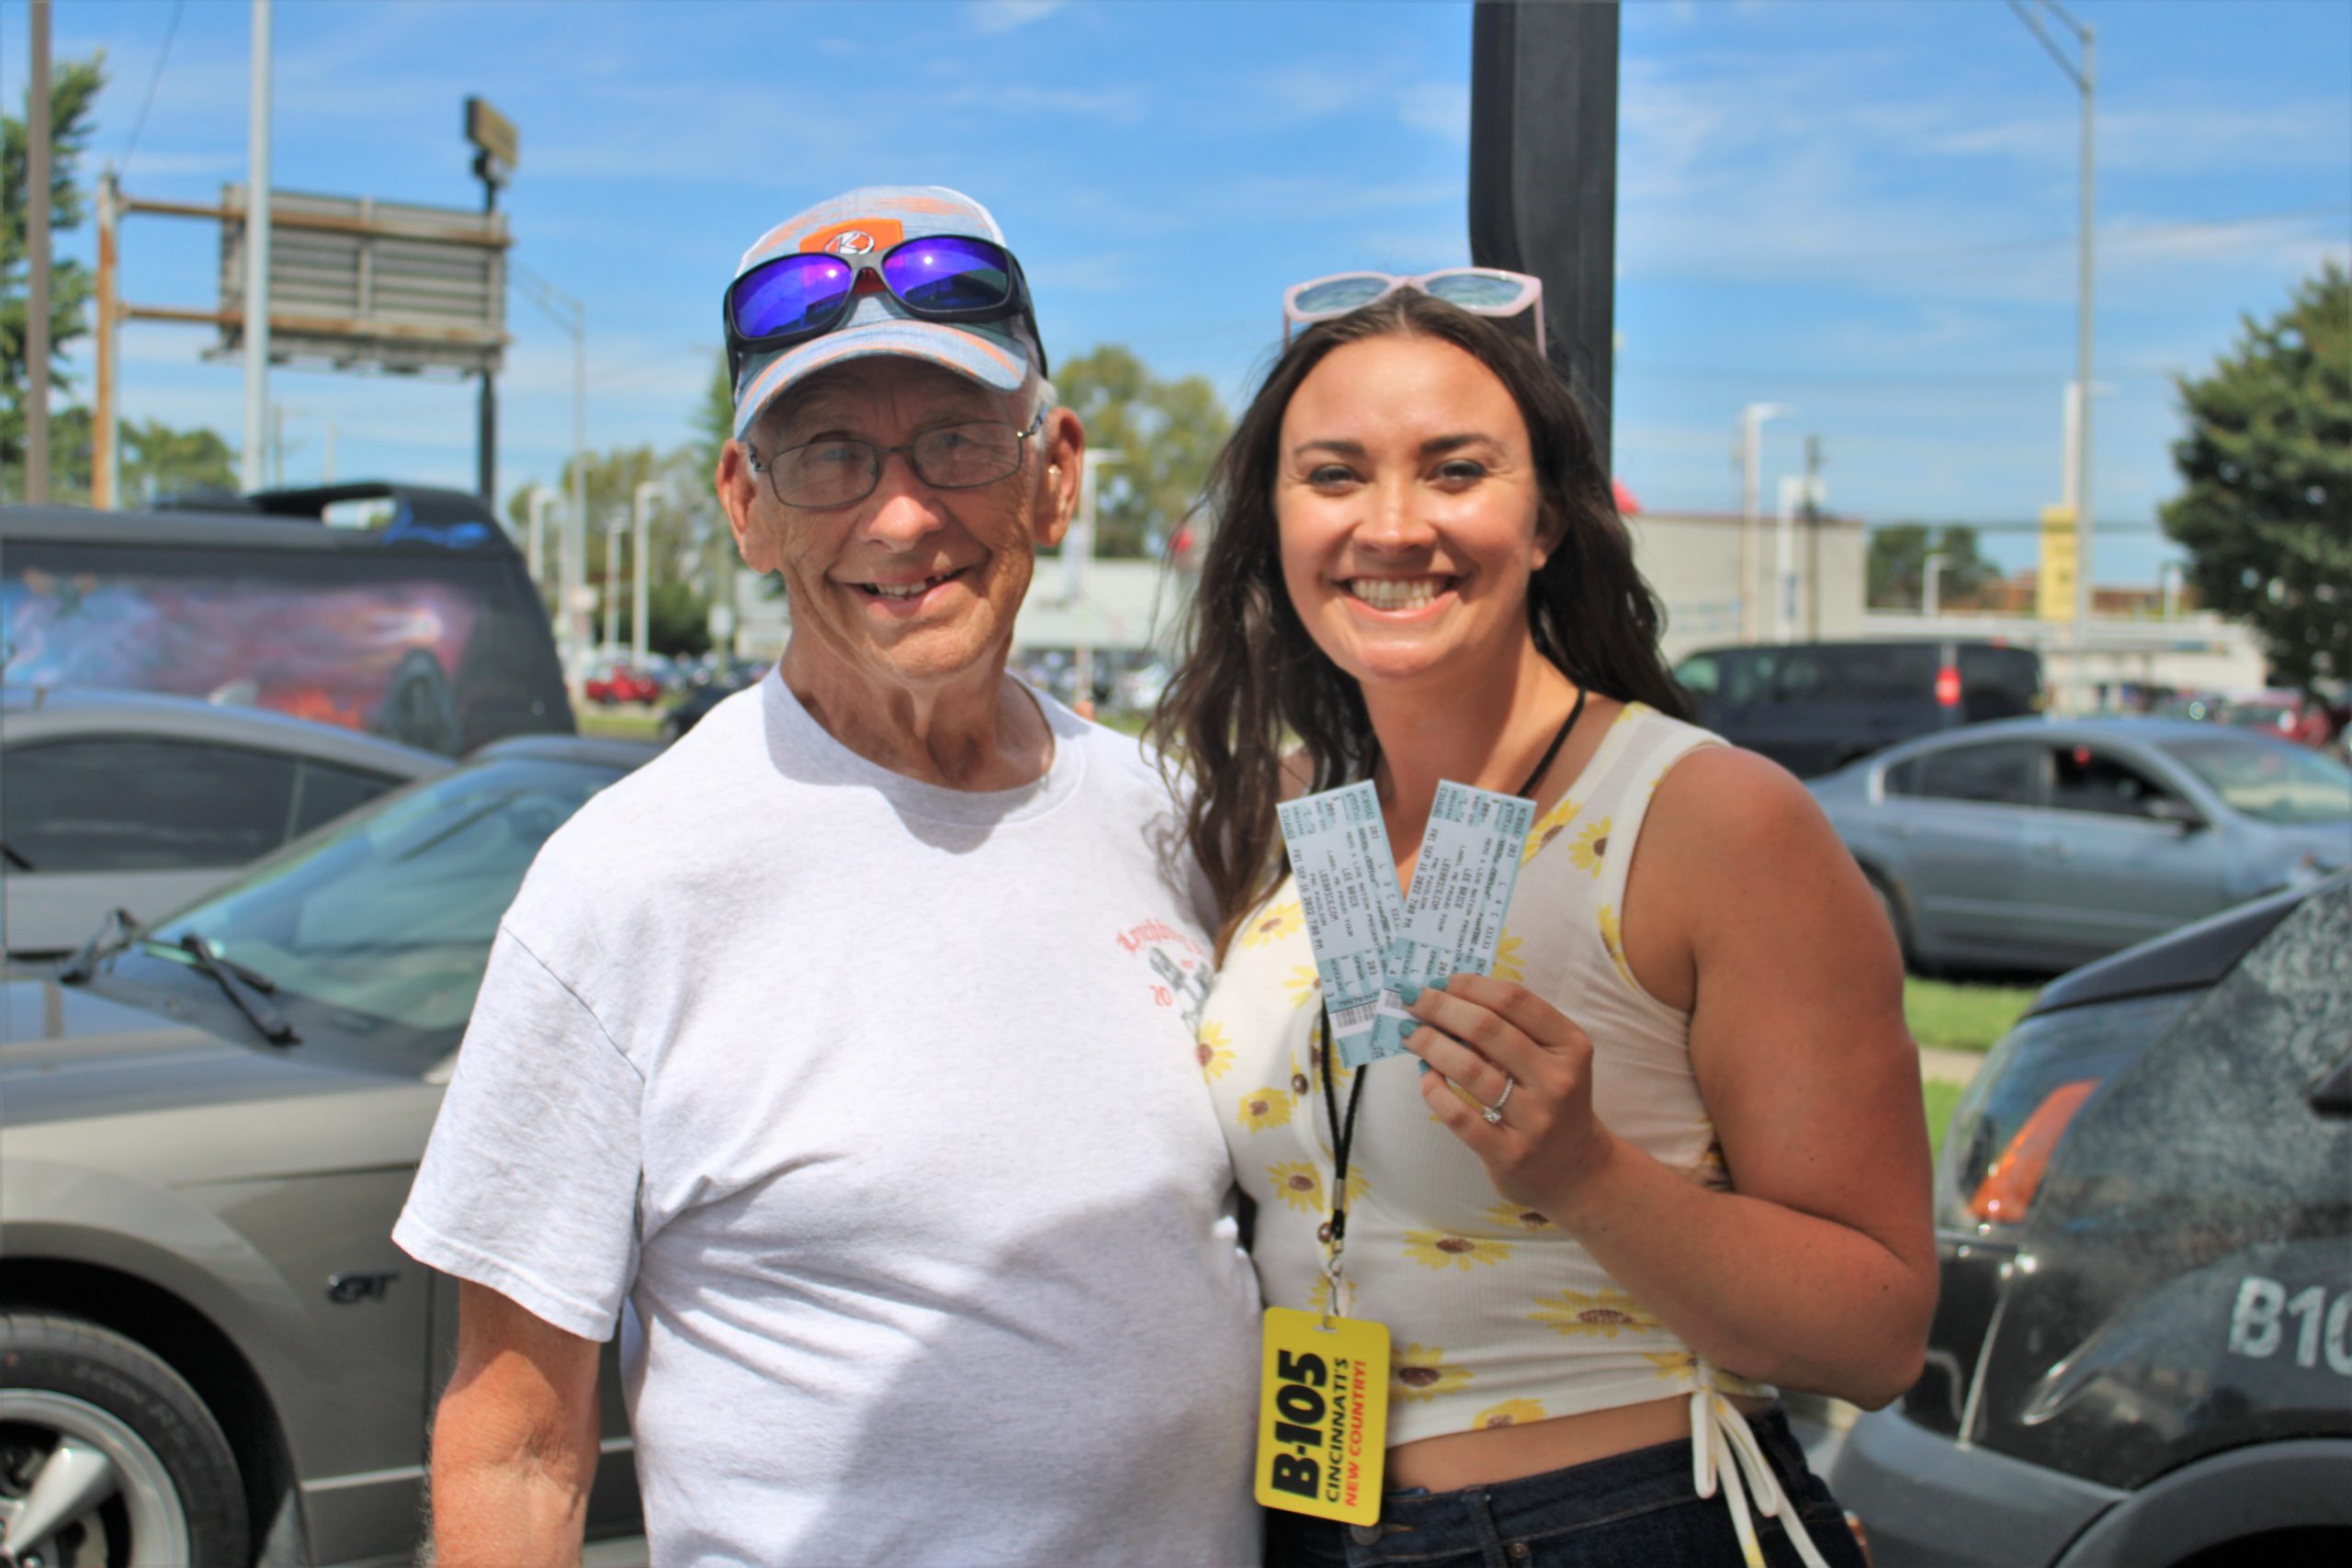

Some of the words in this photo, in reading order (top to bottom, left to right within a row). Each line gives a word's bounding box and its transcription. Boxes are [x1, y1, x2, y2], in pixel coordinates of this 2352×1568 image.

[1368, 825, 1380, 840] 203
[1426, 828, 1438, 841] FRI
[1291, 848, 1302, 863] FRI
[1421, 844, 1433, 859] SEP
[1506, 842, 1518, 858] 203
[1295, 865, 1306, 880] SEP
[1341, 866, 1352, 882] LEE
[1461, 867, 1473, 883] LEE
[1474, 866, 1484, 885] LIVE
[1352, 861, 1362, 878] LIVE
[1358, 882, 1370, 909] NATION
[1412, 874, 1425, 895] 2022
[1419, 874, 1434, 910] PAVILION
[1430, 858, 1452, 911] LEEBRICE.COM
[1303, 896, 1316, 915] 2022
[1346, 885, 1359, 908] BRICE
[1443, 886, 1454, 909] PROUD
[1453, 886, 1467, 908] BRICE
[1465, 888, 1478, 916] NATION
[1313, 890, 1328, 926] PAVILION
[1337, 890, 1348, 915] PROUD
[1344, 919, 1353, 937] TOUR
[1407, 898, 1419, 915] 7:00
[1308, 918, 1321, 936] 7:00
[1403, 918, 1414, 929] PM
[1437, 913, 1447, 932] TOUR
[1314, 938, 1325, 950] PM
[1365, 959, 1378, 976] 203
[1436, 961, 1448, 977] 203
[1349, 1360, 1366, 1456] COUNTRY!
[1272, 1349, 1328, 1499] B-105
[1326, 1358, 1349, 1503] CINCINNATI'S
[1345, 1463, 1360, 1506] NEW
